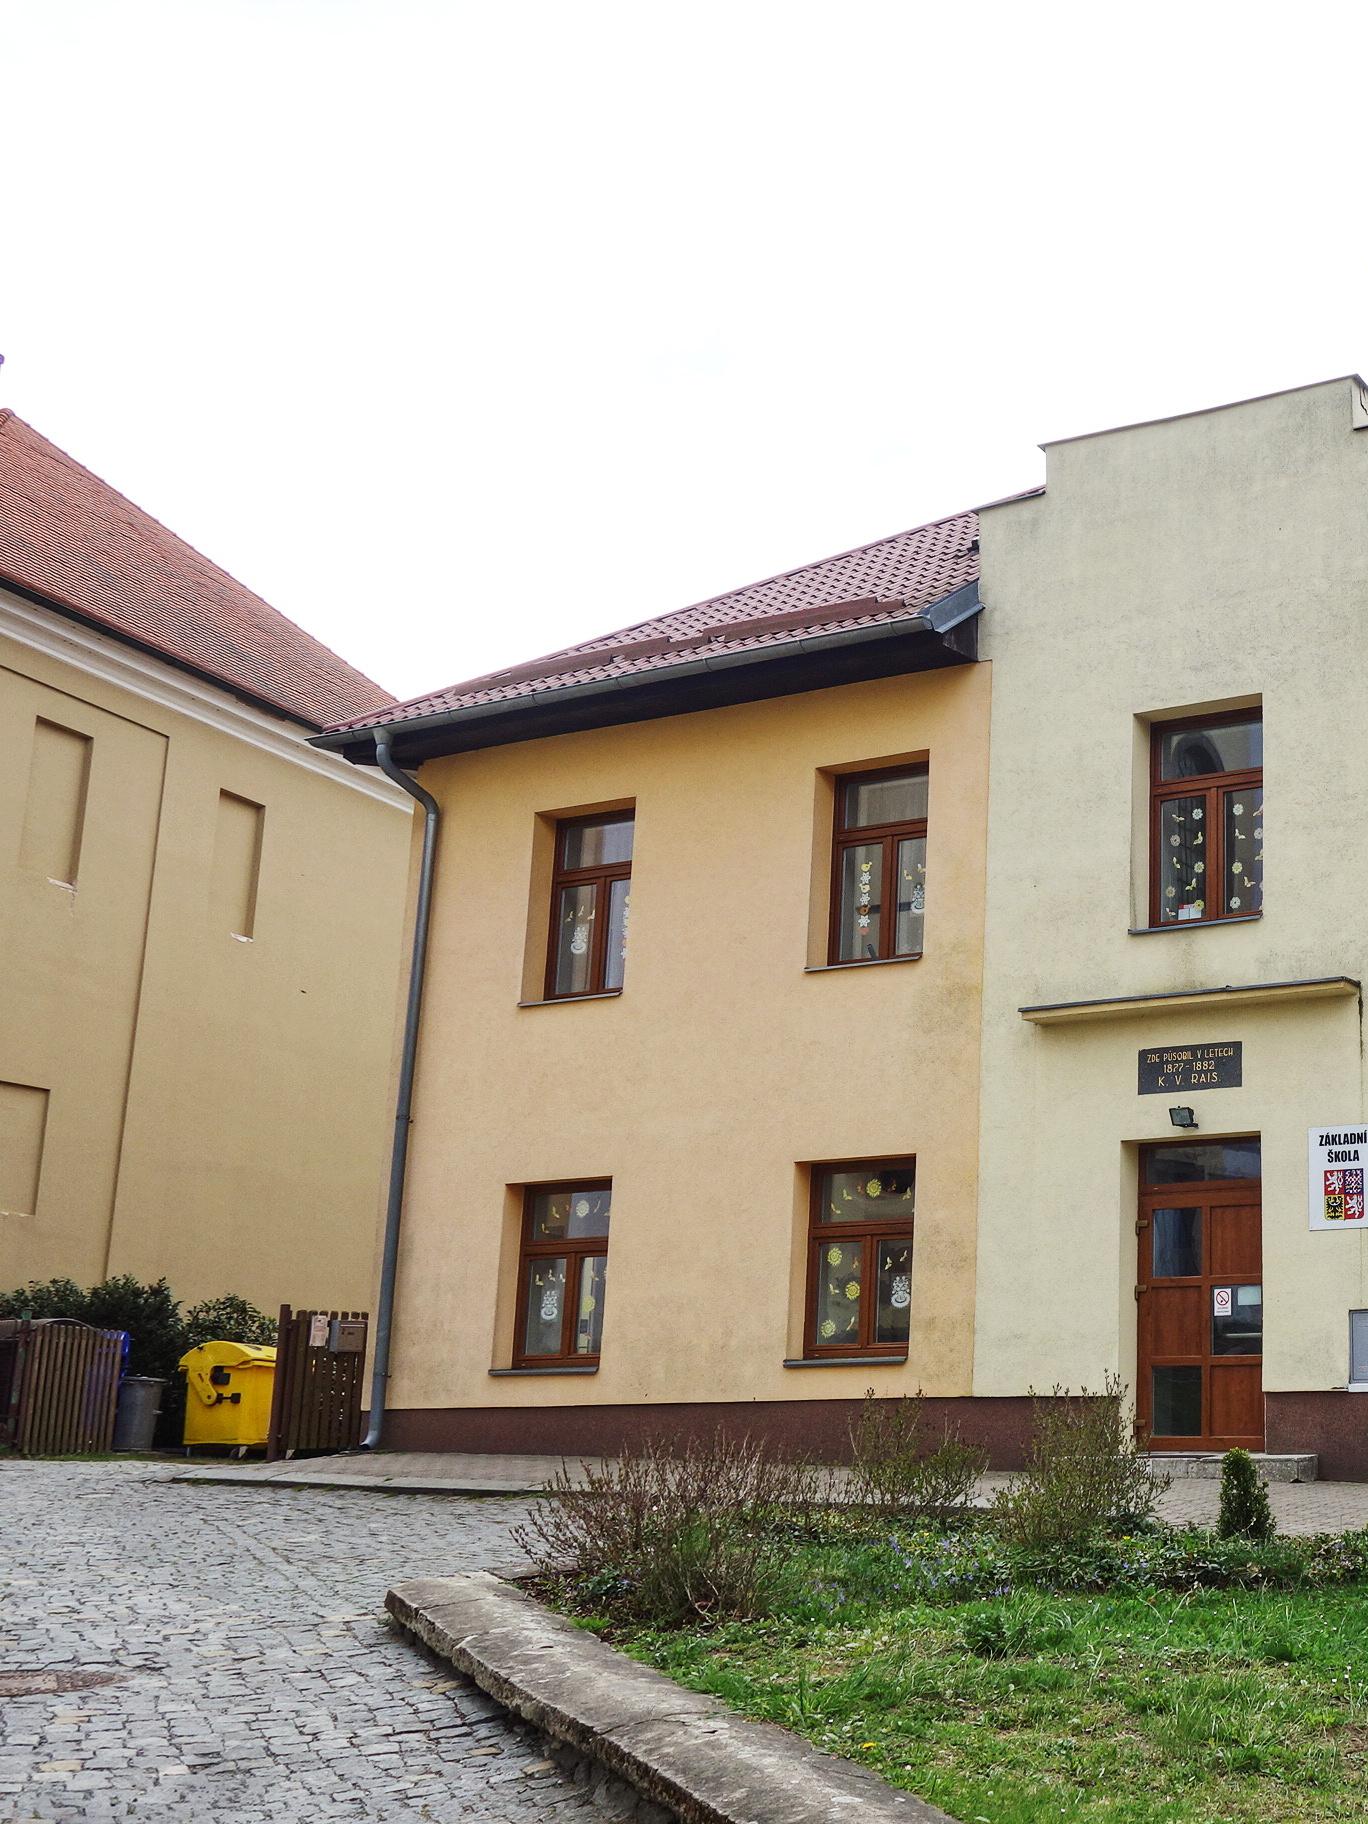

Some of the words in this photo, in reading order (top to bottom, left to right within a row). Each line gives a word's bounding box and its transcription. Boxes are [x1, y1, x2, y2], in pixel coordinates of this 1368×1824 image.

[1147, 1054, 1159, 1063] ZDE
[1164, 1051, 1193, 1061] PŮSOBIL
[1197, 1050, 1201, 1058] V
[1205, 1048, 1233, 1058] LETECH
[1319, 1130, 1367, 1146] ZÁKLADNÍ
[1327, 1149, 1359, 1163] ŠKOLA
